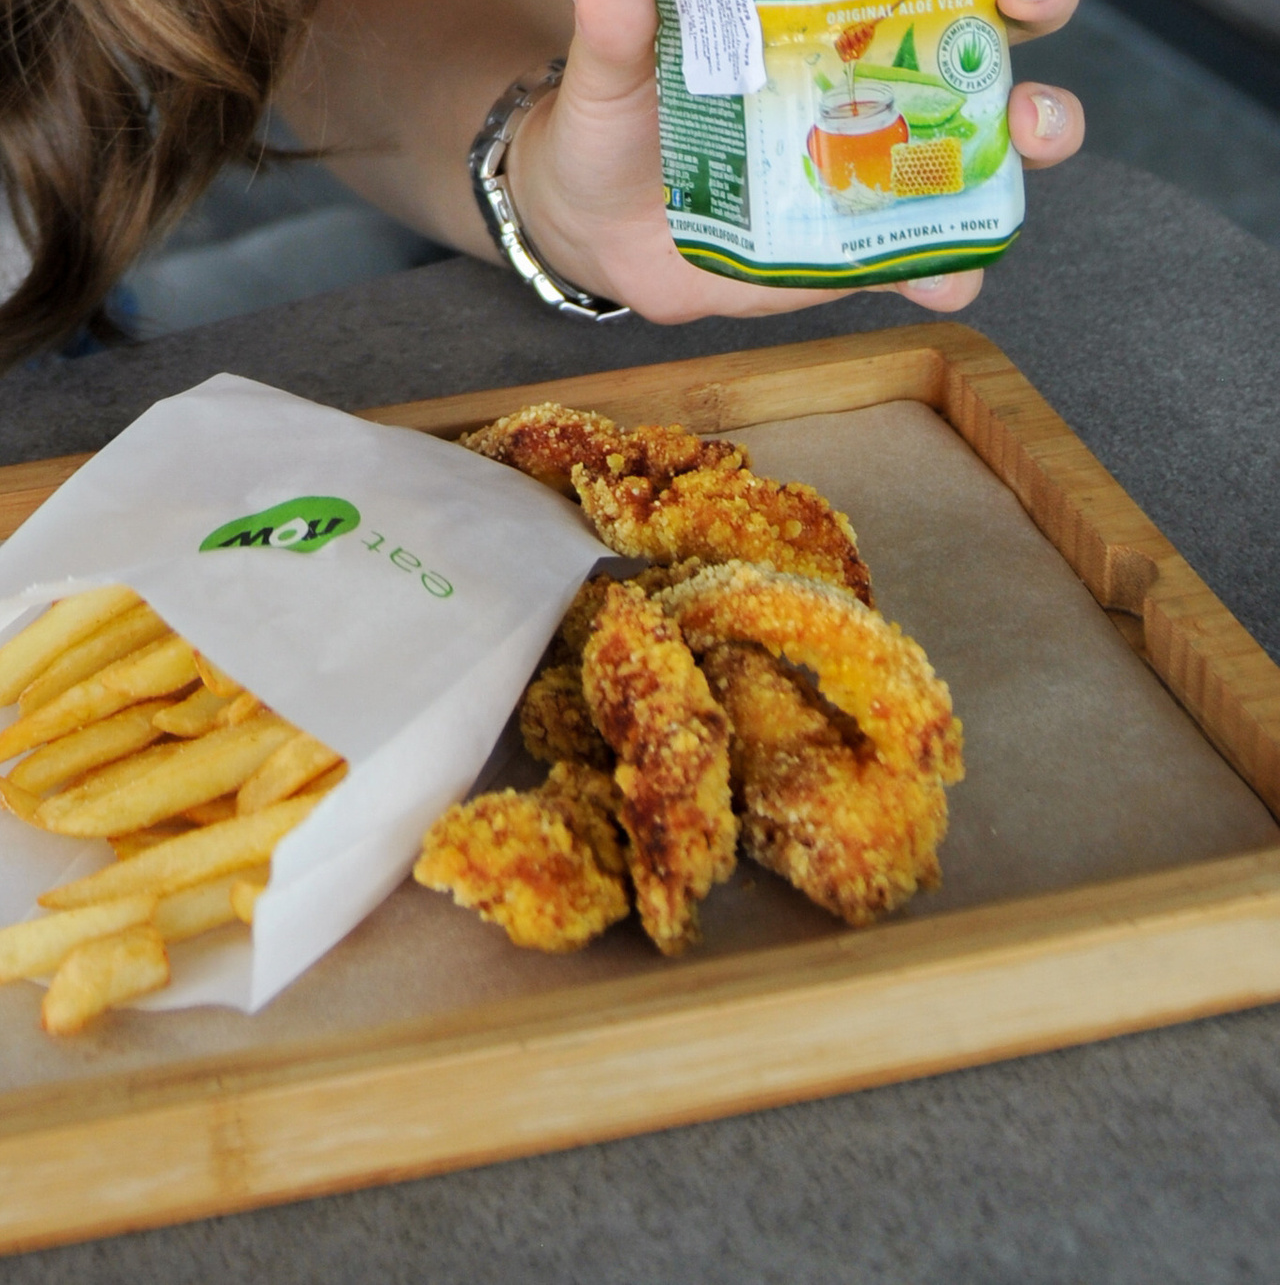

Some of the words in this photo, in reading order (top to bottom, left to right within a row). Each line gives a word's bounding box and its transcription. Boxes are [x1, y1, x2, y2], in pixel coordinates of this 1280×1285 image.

[826, 5, 895, 25] ORIGINAL
[941, 21, 972, 53] PREMIUM
[974, 22, 1001, 53] QUALITY
[941, 59, 963, 88] HONEY
[965, 60, 1000, 90] FLAVOUR
[841, 237, 873, 254] PURE
[876, 234, 885, 245] &
[889, 223, 945, 242] NATURAL
[960, 218, 1000, 232] HONEY
[217, 516, 346, 548] now
[360, 530, 454, 599] eat
